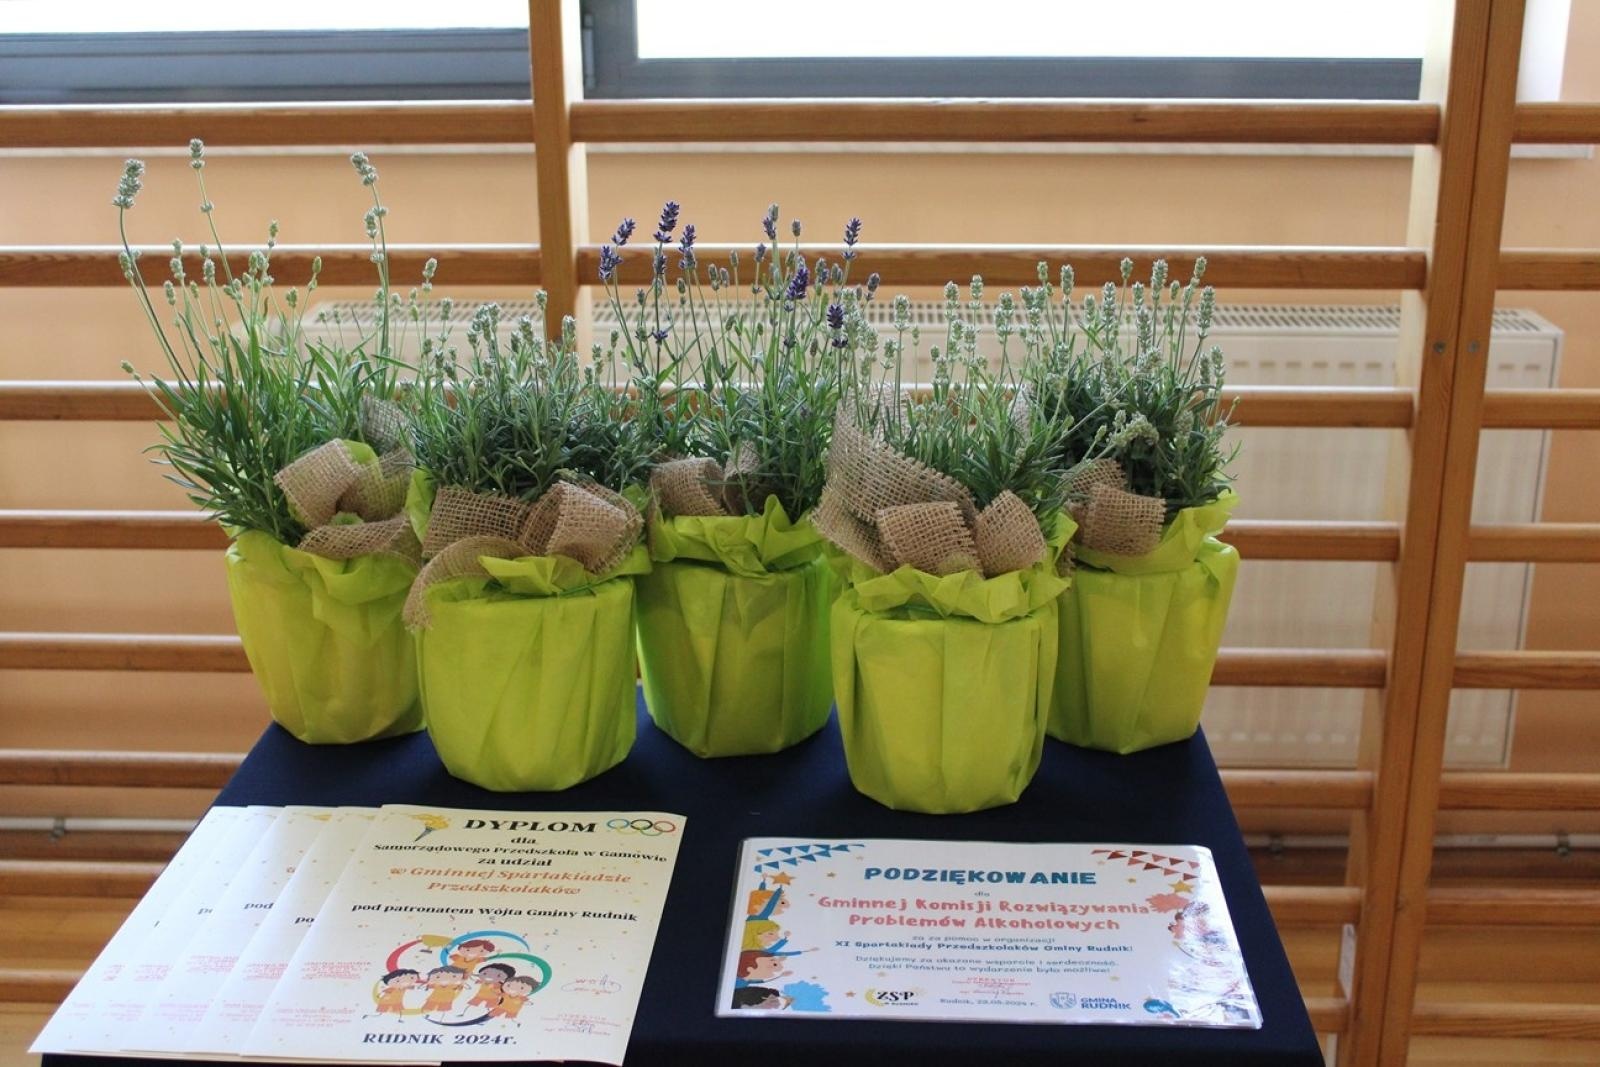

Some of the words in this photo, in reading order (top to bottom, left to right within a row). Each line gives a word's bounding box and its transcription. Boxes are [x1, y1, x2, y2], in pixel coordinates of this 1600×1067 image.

[464, 819, 597, 833] DYPLOM
[511, 836, 537, 844] dla
[494, 846, 579, 857] Przedszkola
[390, 867, 407, 875] w
[410, 866, 495, 879] Gminnej
[497, 870, 632, 883] Spartakiadzie
[864, 867, 1097, 885] PODZIĘKOWANIE
[427, 881, 582, 895] Przedszkolaków
[244, 902, 274, 910] pod
[352, 903, 382, 912] pod
[384, 904, 474, 914] patronatem
[526, 908, 577, 918] Gminy
[582, 910, 639, 921] Rudnik
[818, 896, 907, 911] Gminnej
[915, 898, 992, 914] Komisji
[999, 900, 1149, 915] Rozwiązywania
[849, 914, 966, 928] Problemów
[974, 917, 1121, 932] Alkoholowych
[855, 941, 932, 950] Spartakiady
[937, 942, 1039, 951] Przedszkolaków
[876, 991, 914, 1001] ZSP
[1080, 1002, 1132, 1010] RUDNIK
[362, 1032, 443, 1045] RUDNIK
[454, 1032, 517, 1045] 2024r.
